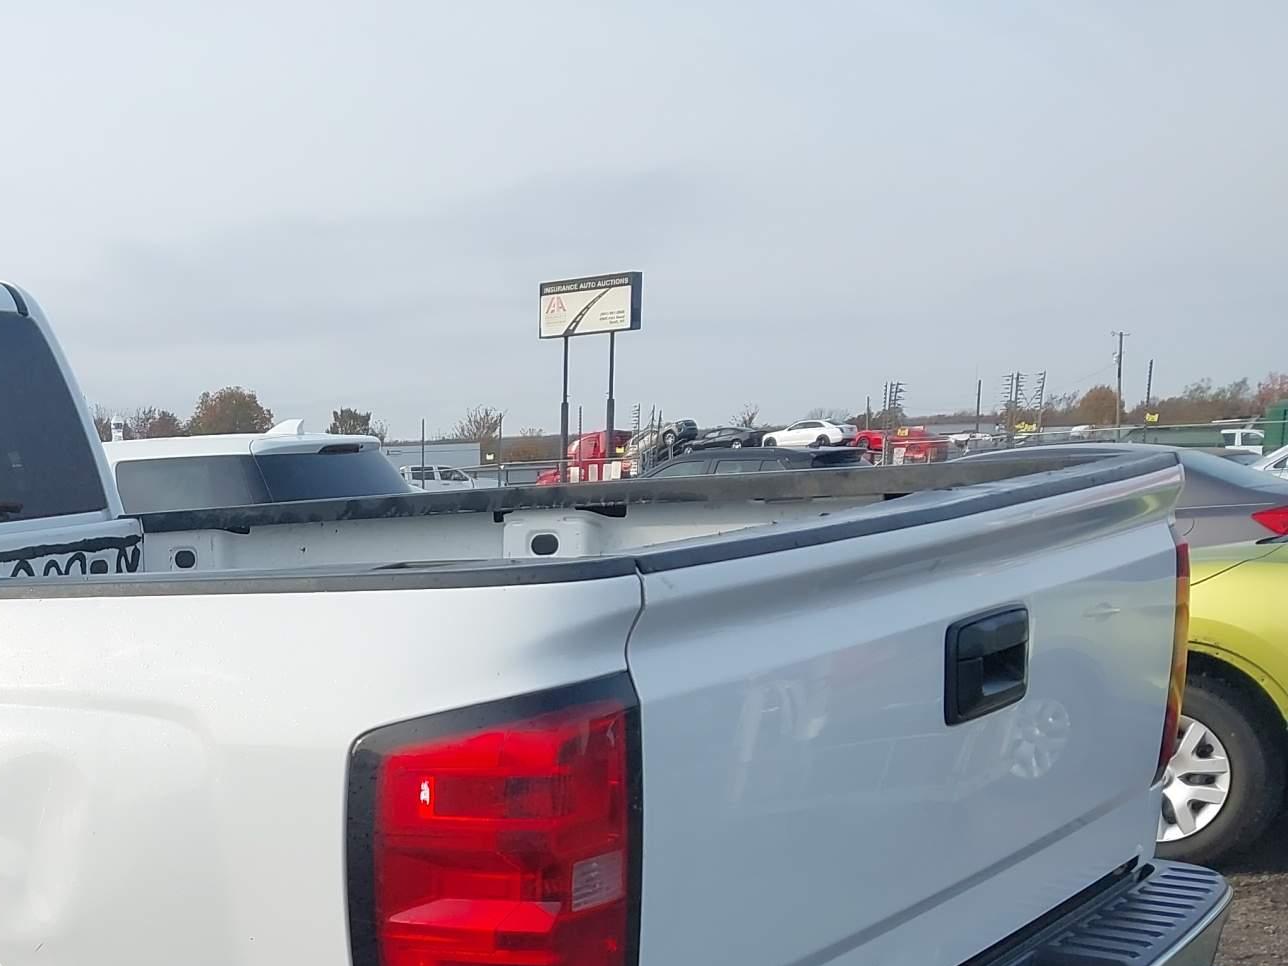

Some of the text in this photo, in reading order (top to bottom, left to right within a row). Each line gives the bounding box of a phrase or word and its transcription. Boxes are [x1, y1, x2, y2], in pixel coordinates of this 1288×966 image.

[543, 277, 629, 294] INSURANCE AUTO AUCTIONS
